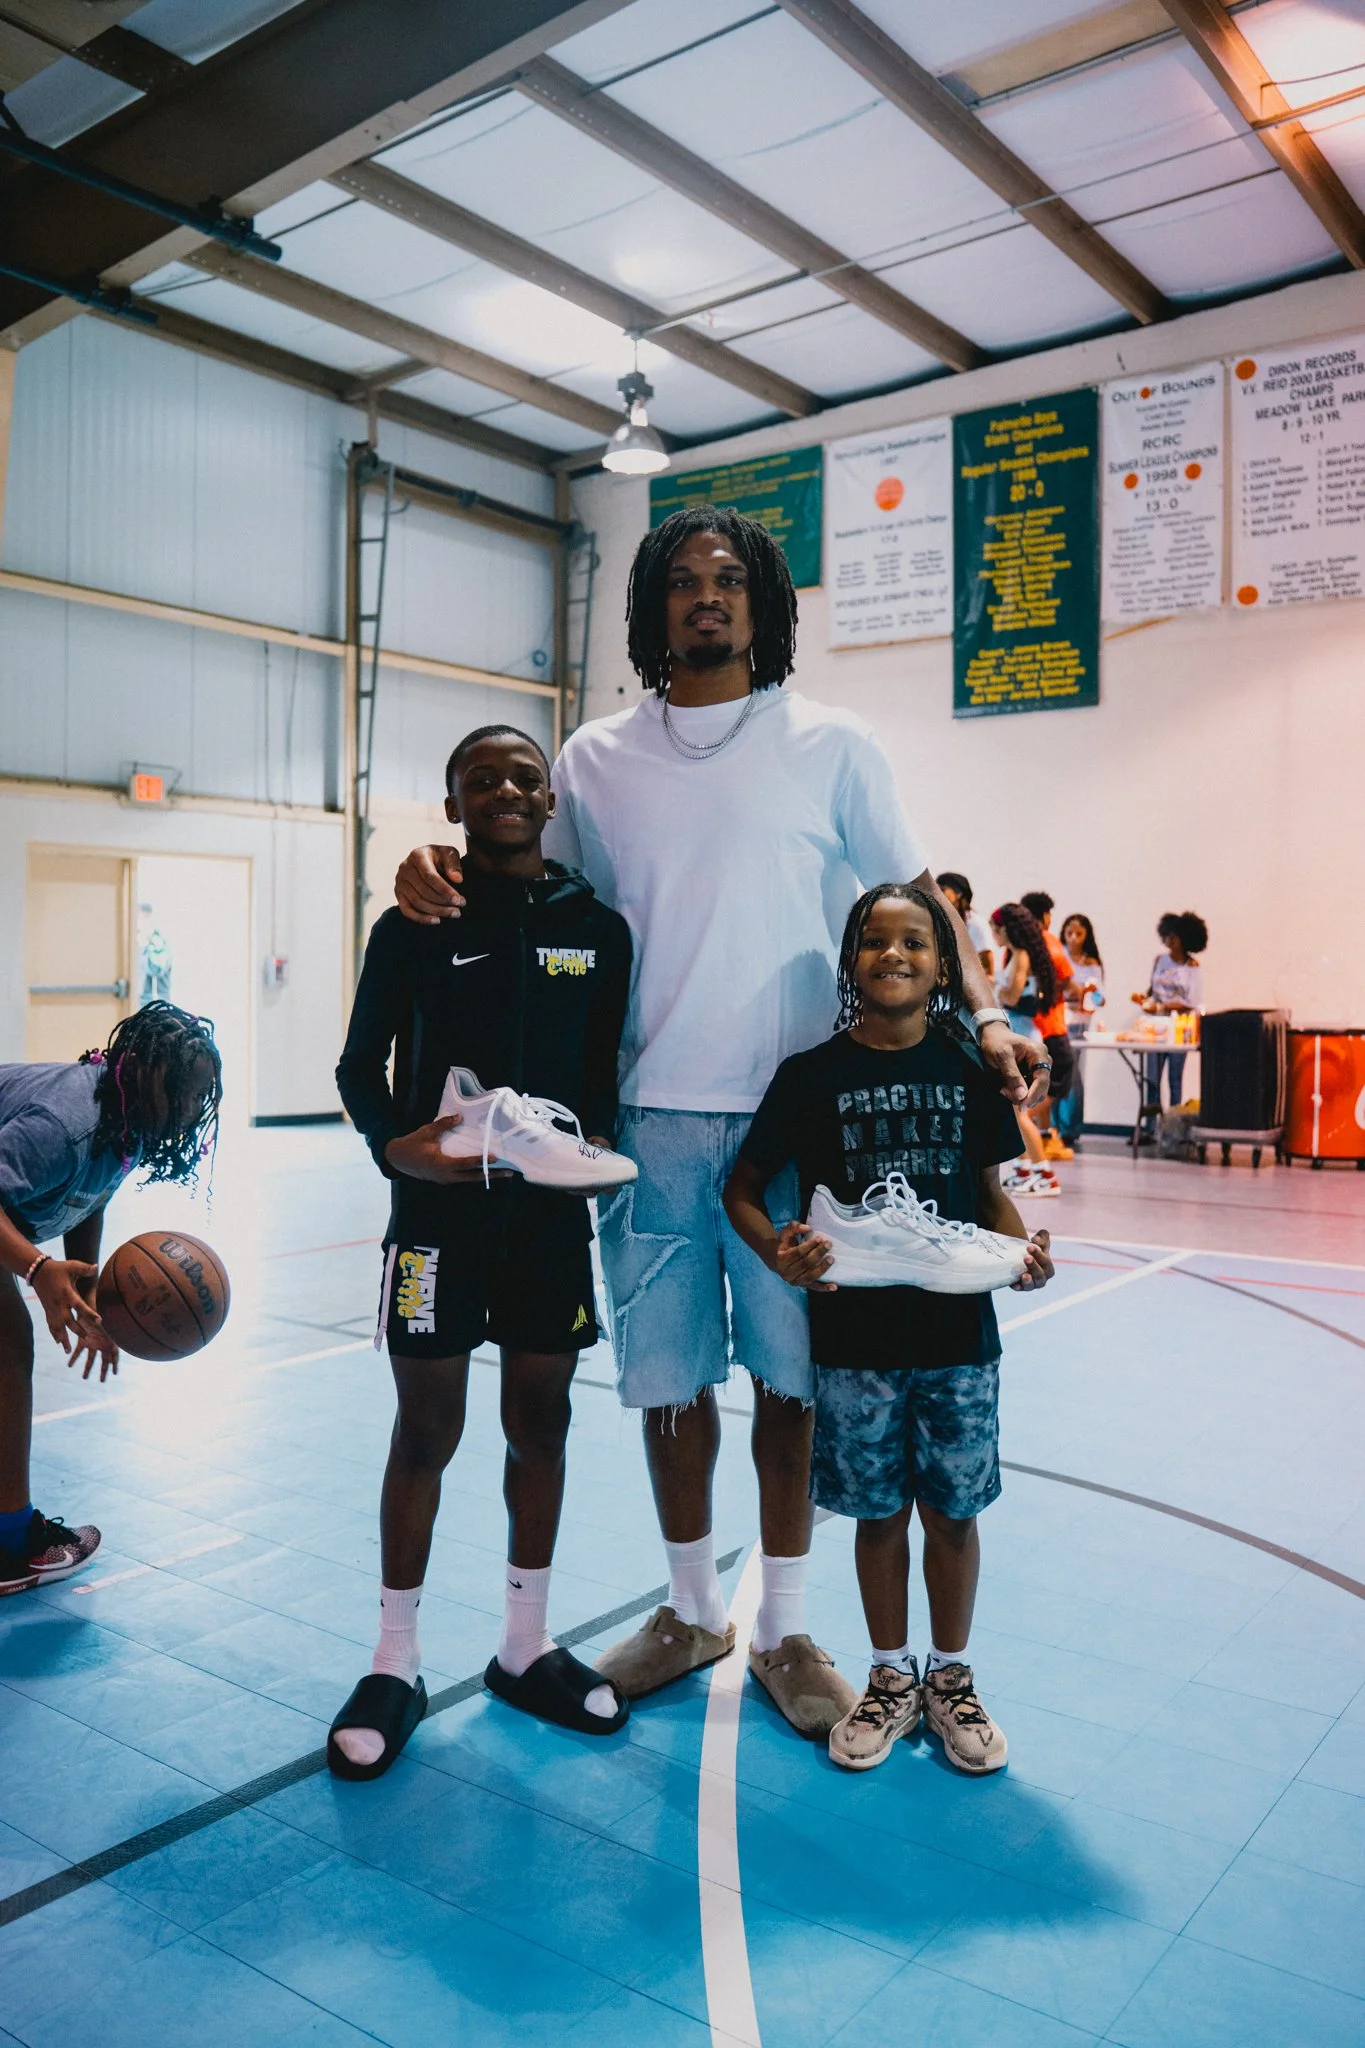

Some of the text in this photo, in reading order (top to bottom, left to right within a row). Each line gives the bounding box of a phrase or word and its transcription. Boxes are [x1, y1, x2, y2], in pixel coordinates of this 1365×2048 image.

[1268, 350, 1357, 378] DIRON RECORDS
[1111, 390, 1137, 404] OUT
[1161, 375, 1216, 395] BOUNDS
[1263, 377, 1288, 392] REID
[1290, 372, 1314, 387] 2000
[1289, 381, 1334, 400] CHAMPS
[1255, 403, 1301, 420] MEADOW
[1307, 395, 1335, 412] LAKE
[1312, 412, 1324, 425] 10
[1011, 422, 1064, 442] Champions
[1300, 433, 1311, 444] 12
[1319, 430, 1324, 439] 1
[1036, 445, 1089, 465] Champions
[1146, 468, 1178, 483] 1998
[1035, 479, 1044, 498] 0
[1146, 500, 1160, 513] 13
[1169, 497, 1179, 510] 0
[837, 1083, 966, 1115] PRACTICE
[841, 1115, 963, 1151] MAKES
[159, 1238, 215, 1315] Wilson
